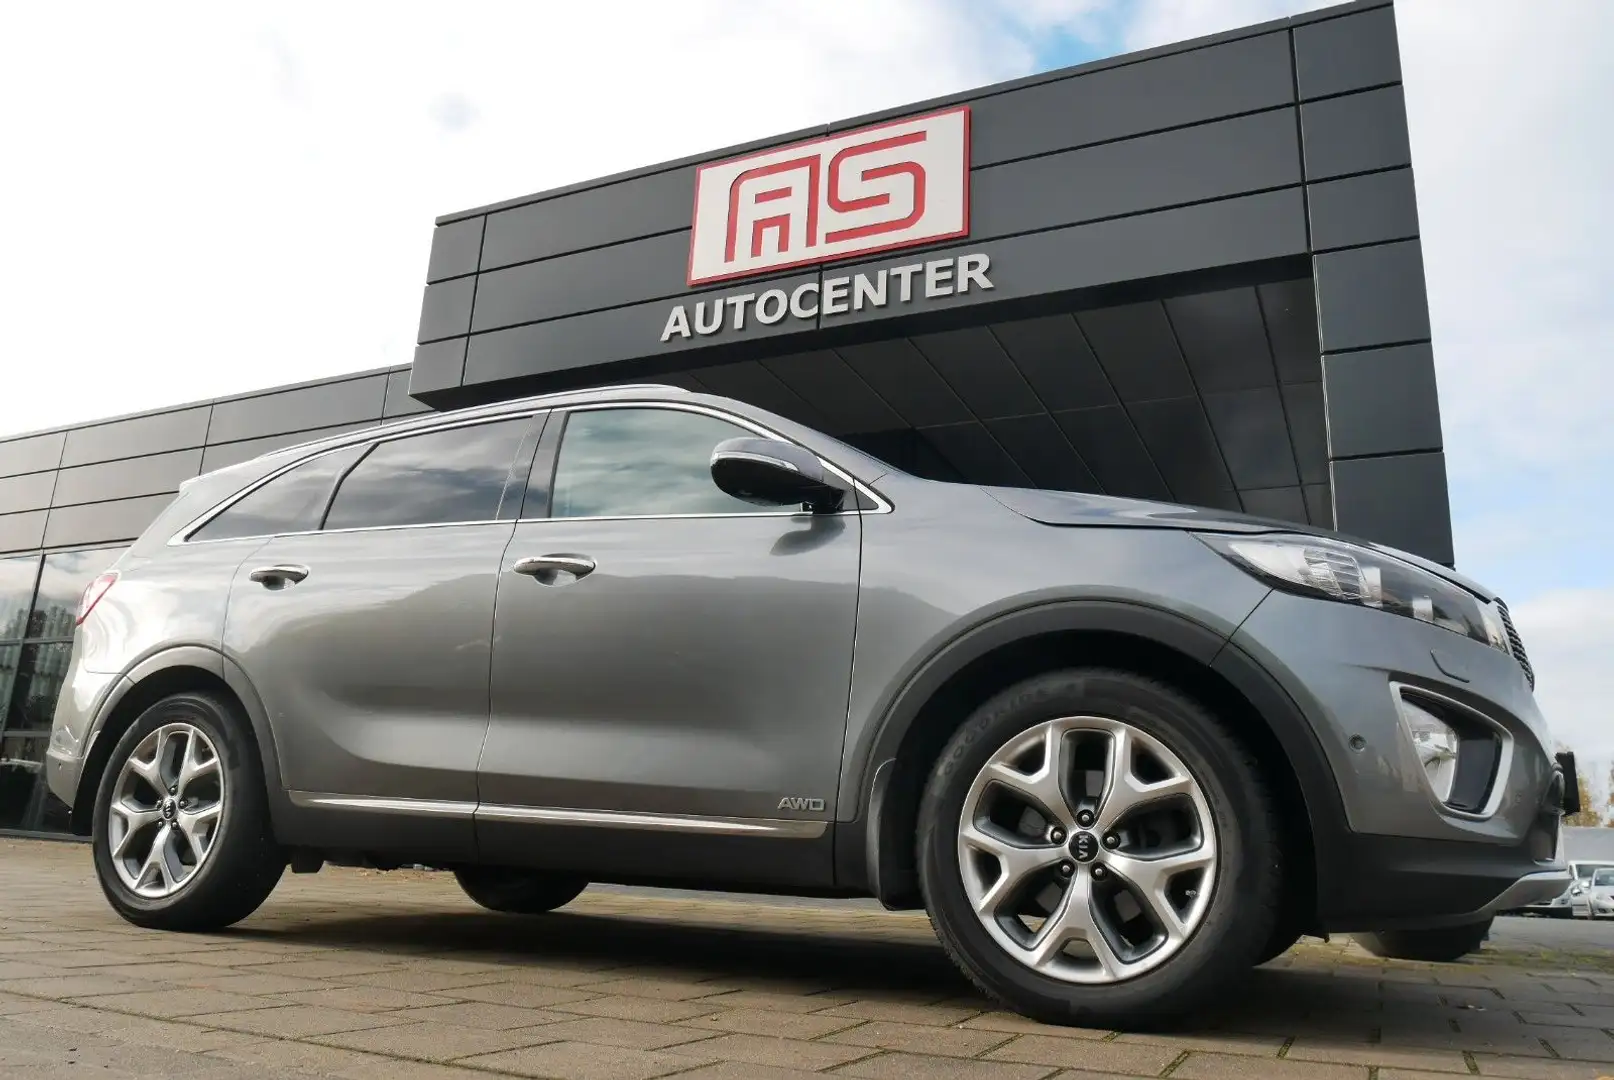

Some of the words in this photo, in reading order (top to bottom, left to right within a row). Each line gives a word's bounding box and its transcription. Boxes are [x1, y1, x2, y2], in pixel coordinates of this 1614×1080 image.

[724, 130, 927, 263] AS
[660, 253, 995, 342] AUTOCENTER
[777, 797, 825, 811] AWD
[1078, 834, 1089, 859] KIA
